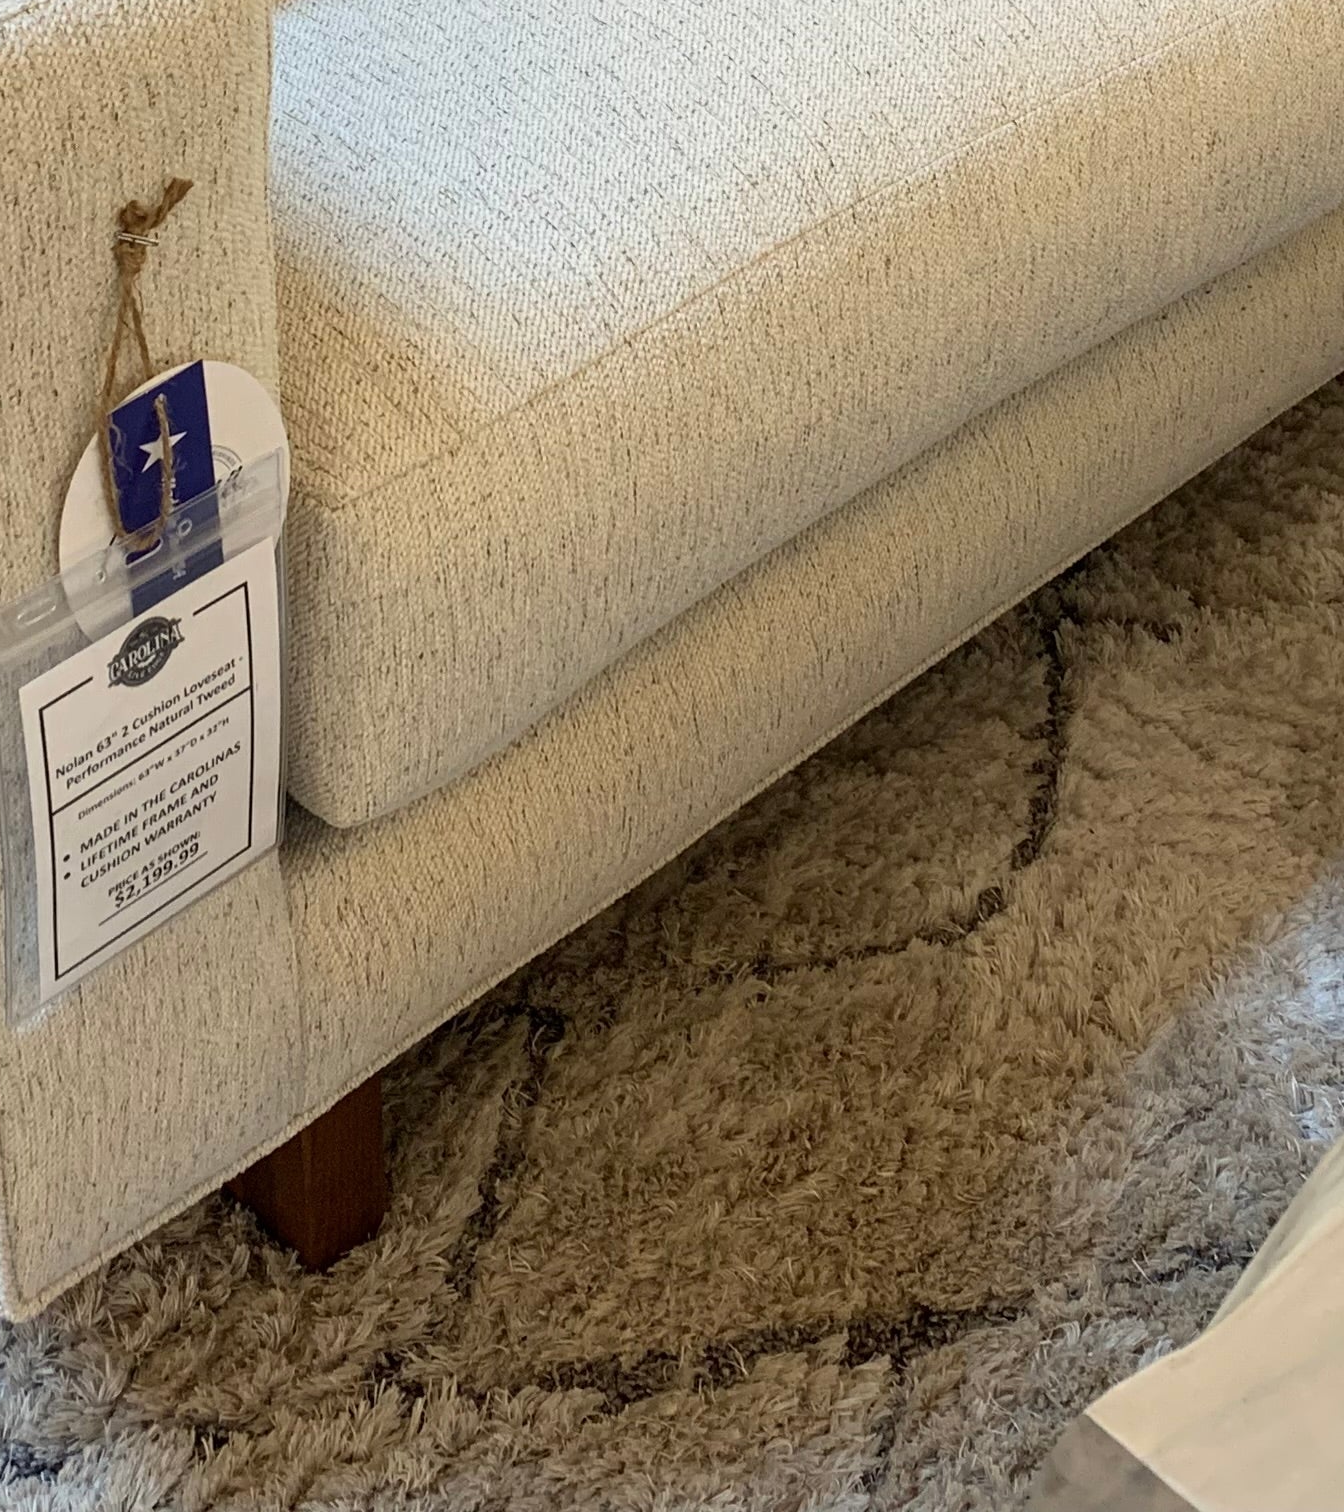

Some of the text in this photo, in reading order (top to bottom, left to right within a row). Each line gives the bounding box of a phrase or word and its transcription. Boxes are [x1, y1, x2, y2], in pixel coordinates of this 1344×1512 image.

[110, 624, 182, 681] CAROLINA
[55, 747, 94, 779] Nolan
[122, 725, 130, 738] 2
[132, 695, 181, 730] Cushion
[183, 661, 237, 698] Loveseat
[66, 673, 236, 790] Performance Natural Tweed
[77, 777, 136, 820] Dimensions:
[80, 740, 242, 854] MADE IN THE CAROLINAS
[80, 773, 219, 872] LIFETIME FRAME AND
[80, 791, 217, 888] CUSHION WARRANTY
[107, 831, 201, 897] PRICE AS SHOWN:
[114, 842, 199, 908] $2,199.99
